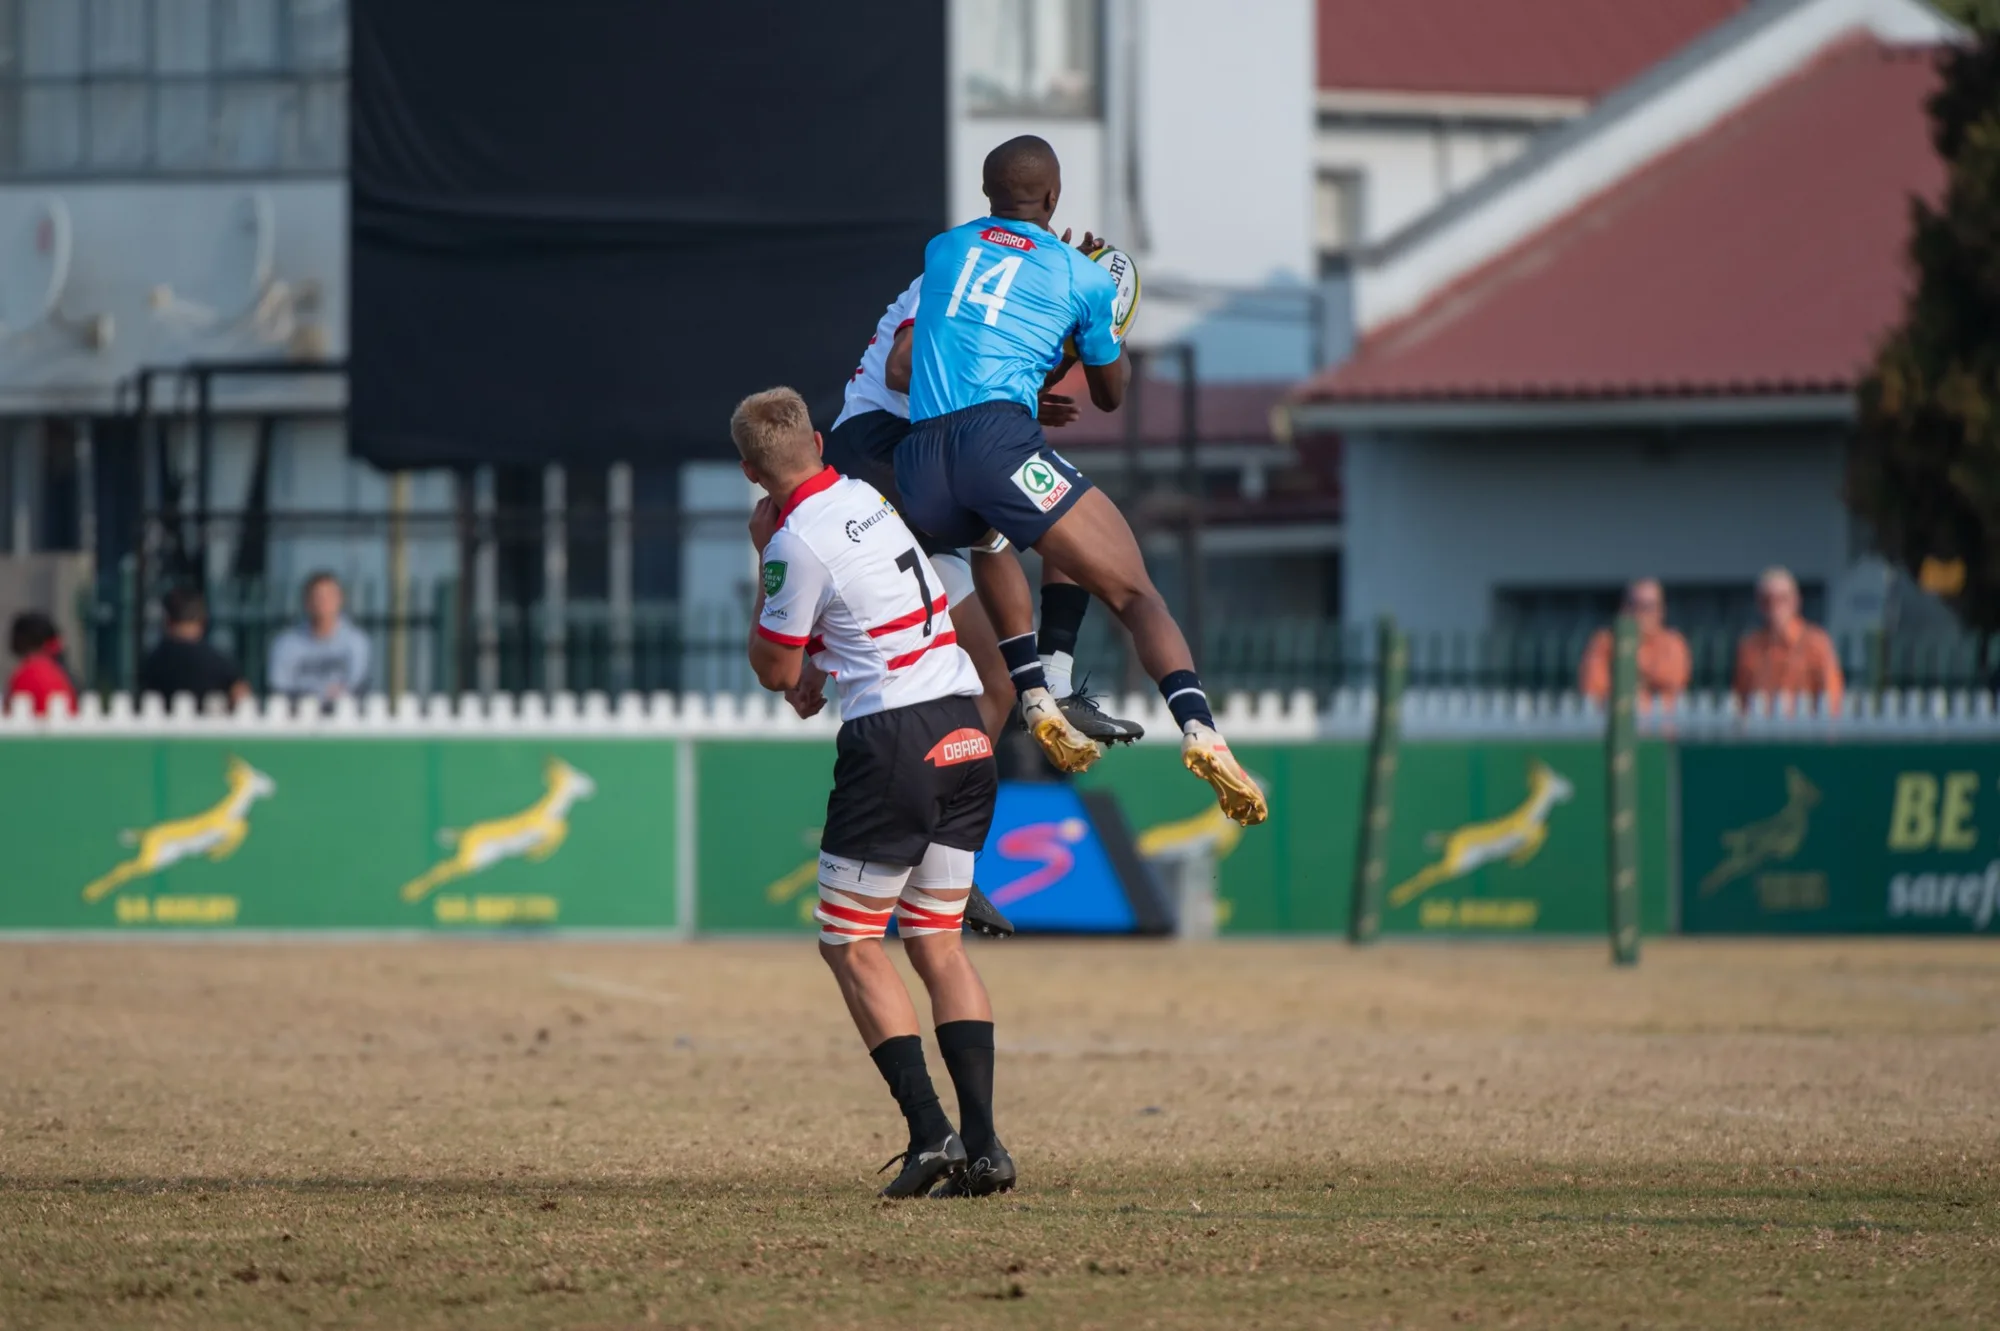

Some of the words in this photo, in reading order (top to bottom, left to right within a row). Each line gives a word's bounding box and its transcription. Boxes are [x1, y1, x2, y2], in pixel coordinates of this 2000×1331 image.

[988, 230, 1027, 249] OBARO
[945, 247, 1024, 327] 14
[1109, 253, 1127, 290] ERT
[1042, 481, 1068, 509] SPAR
[851, 508, 888, 537] FIDELITY
[943, 736, 988, 761] OBARO
[1888, 771, 1979, 852] BE
[1889, 860, 2000, 931] saref
